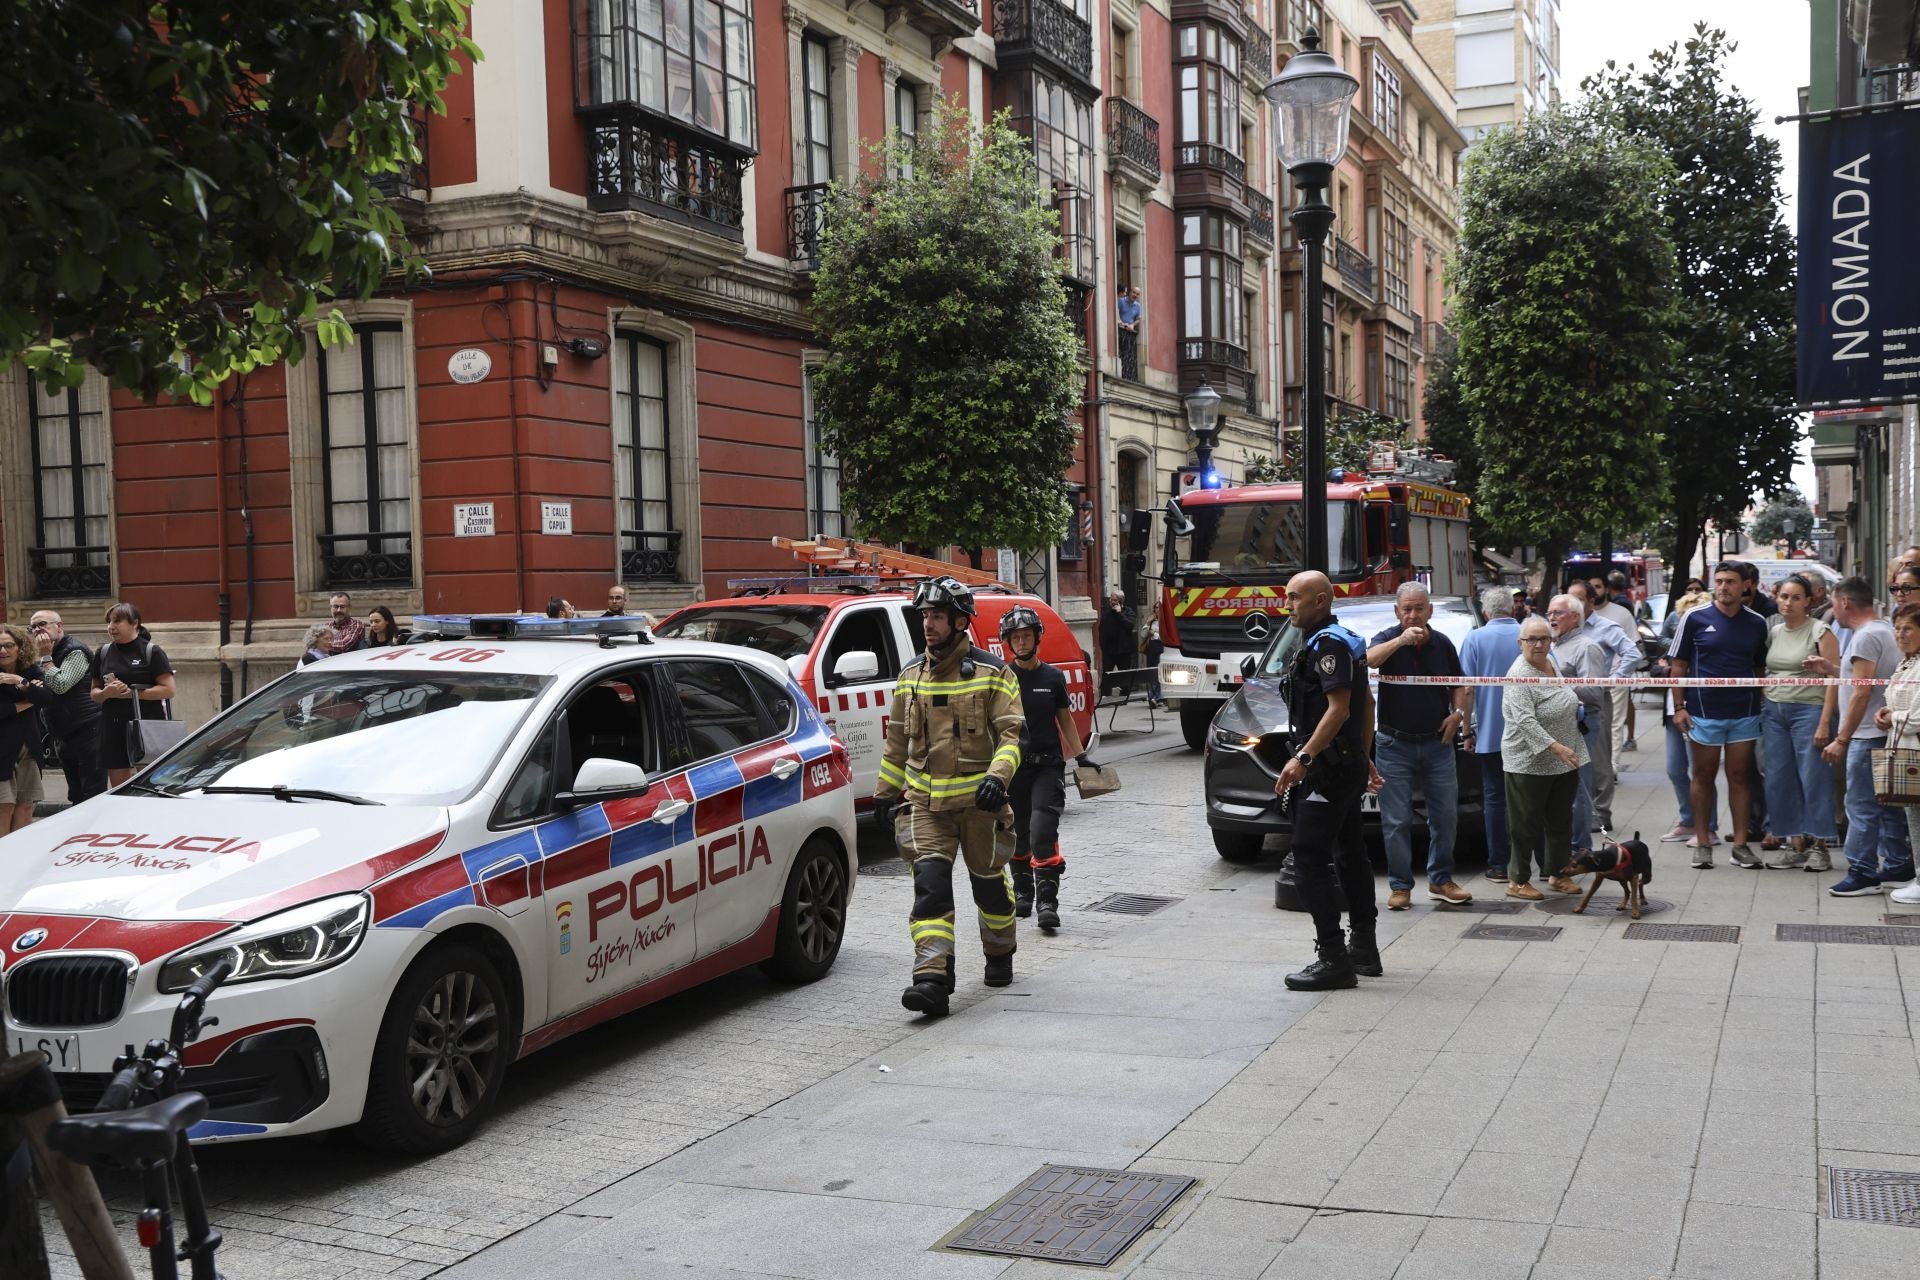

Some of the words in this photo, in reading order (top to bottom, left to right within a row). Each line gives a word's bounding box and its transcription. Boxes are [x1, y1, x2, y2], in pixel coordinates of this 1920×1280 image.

[468, 506, 489, 516] CALLE
[552, 507, 569, 517] CALLE
[467, 517, 492, 526] CASIMIRO
[548, 520, 566, 530] CAPUA
[463, 525, 487, 534] VELASCO
[847, 730, 868, 746] Gijón
[811, 762, 833, 788] 092
[587, 824, 773, 944] POLICÍA
